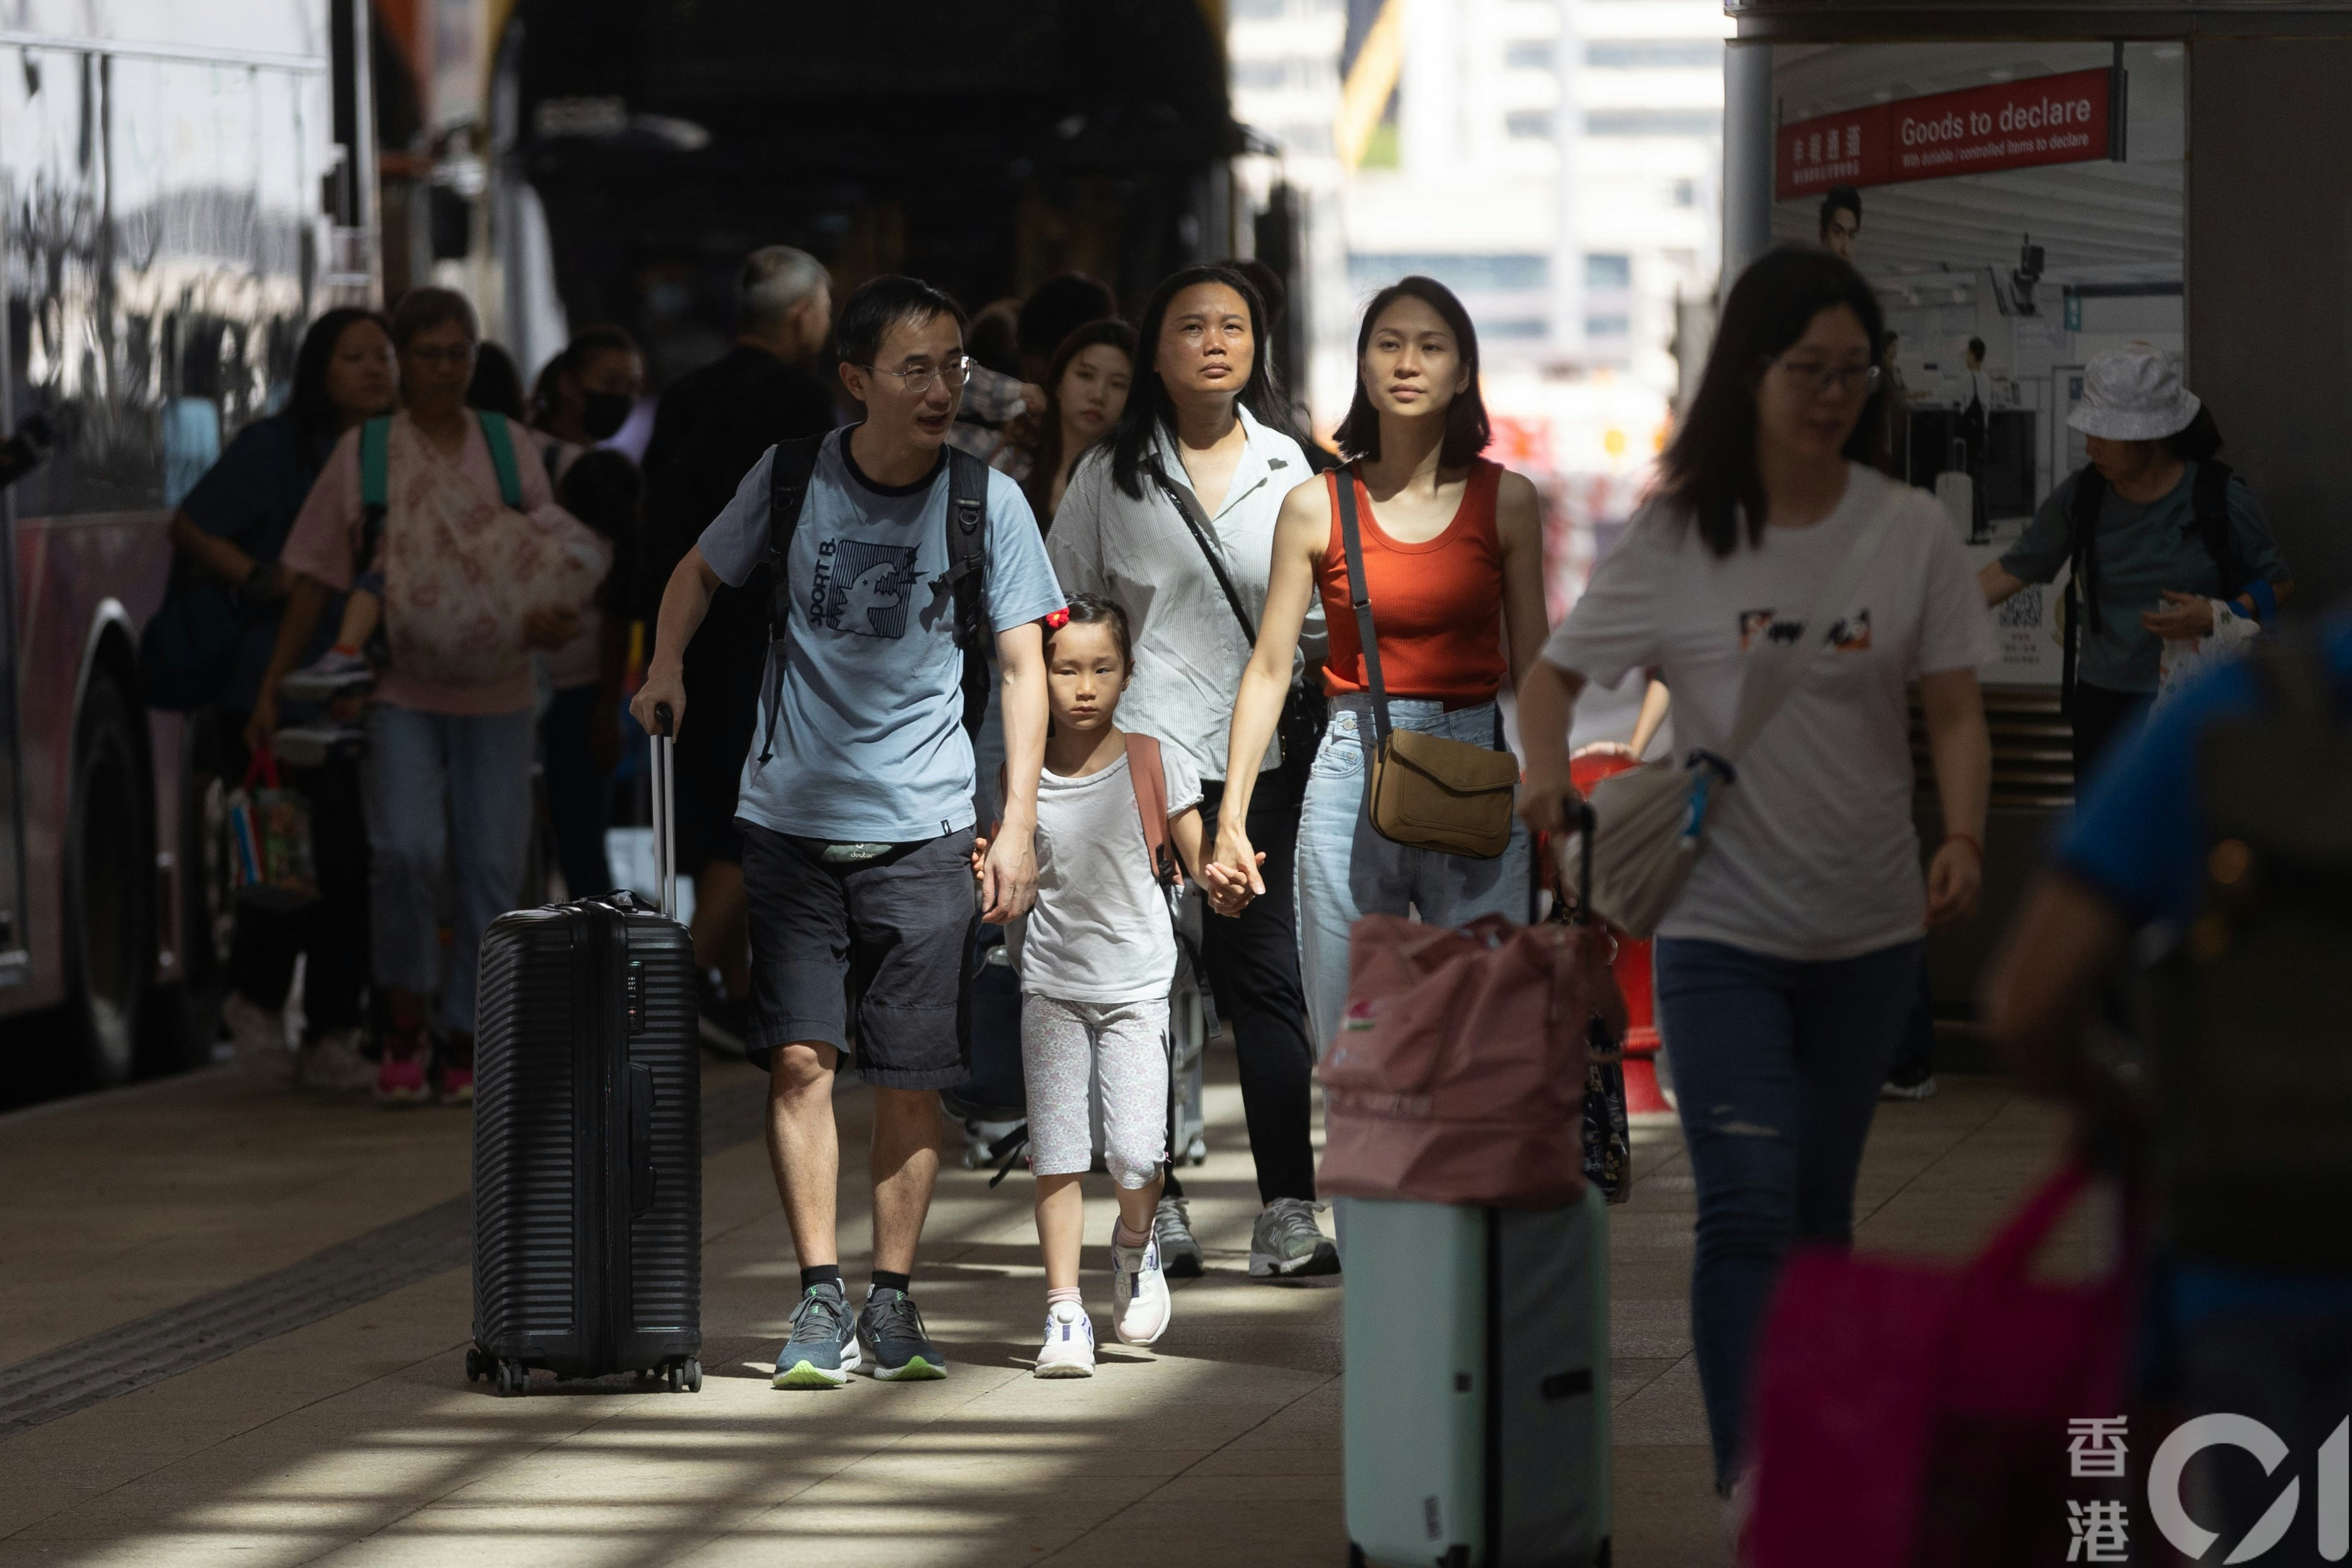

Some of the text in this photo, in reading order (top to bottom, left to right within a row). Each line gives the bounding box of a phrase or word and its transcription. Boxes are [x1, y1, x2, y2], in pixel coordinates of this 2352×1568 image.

[1901, 96, 2091, 146] Goods to declare
[1902, 152, 1920, 168] With
[1959, 141, 2005, 161] controlled
[2007, 137, 2034, 155] items
[2036, 137, 2048, 152] to
[2049, 130, 2090, 150] declare
[819, 538, 836, 556] B.
